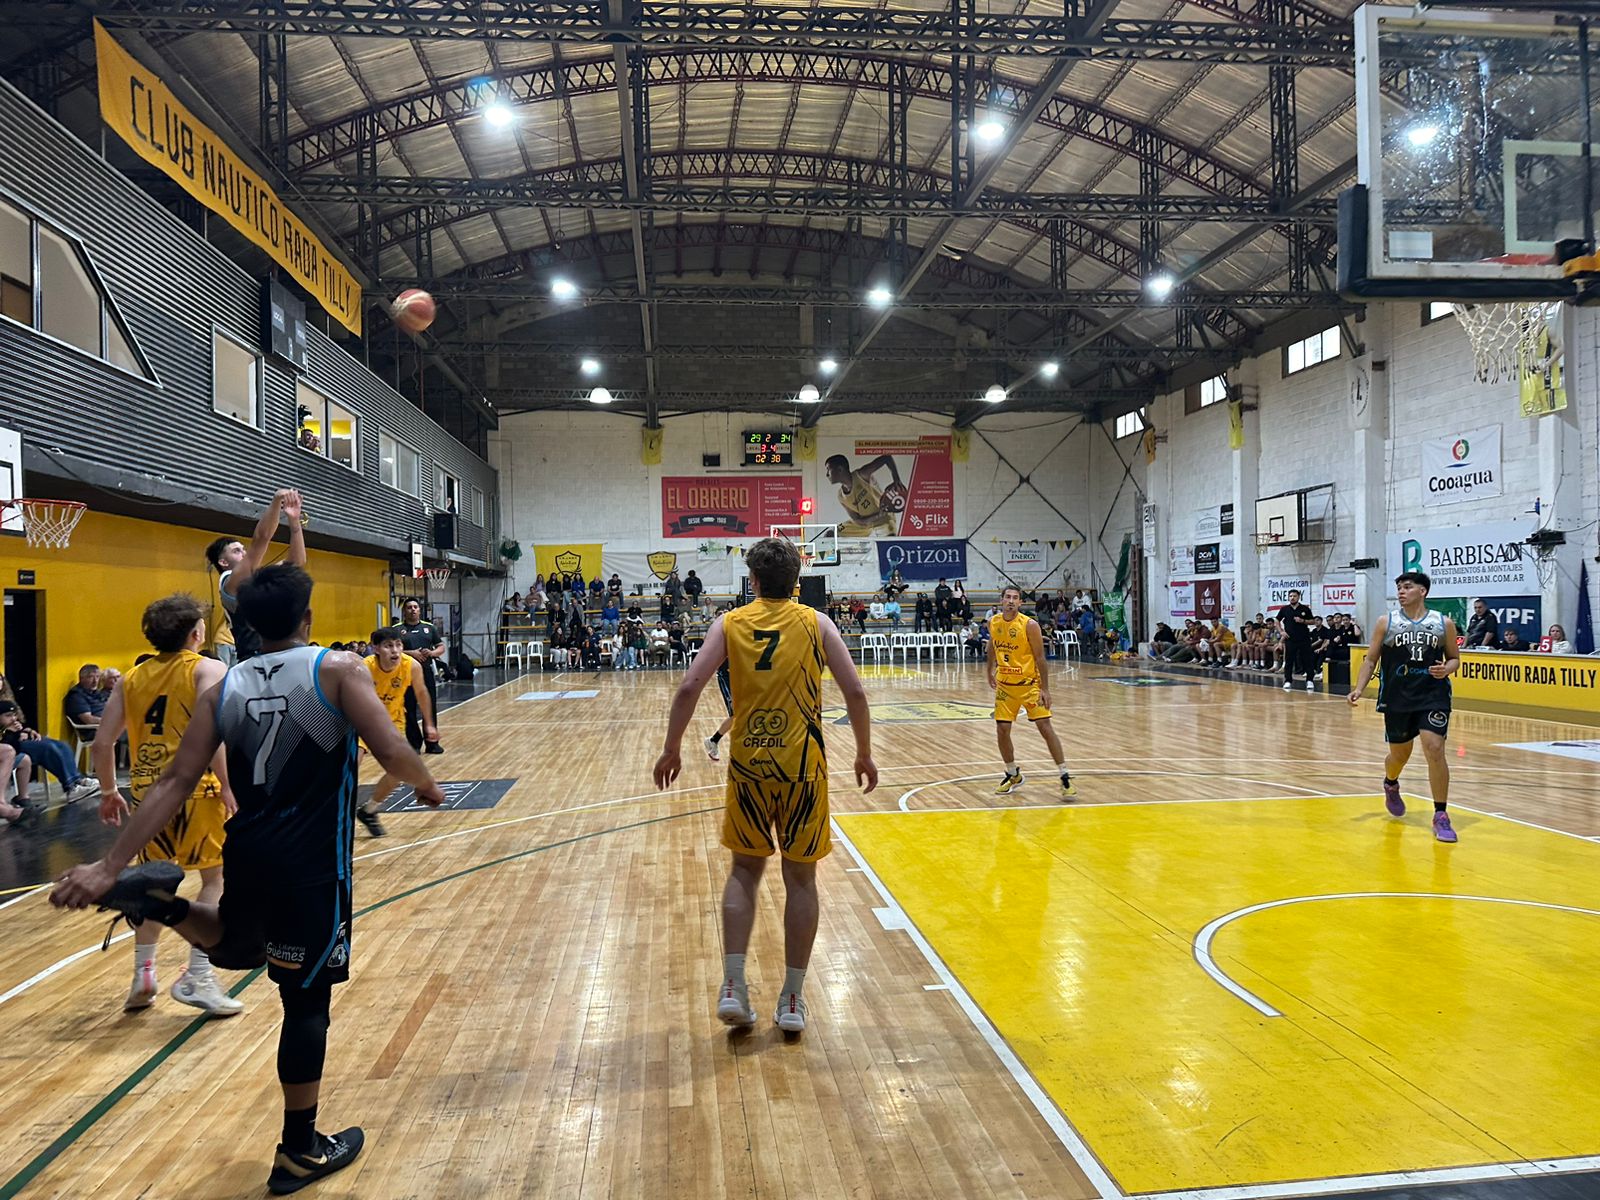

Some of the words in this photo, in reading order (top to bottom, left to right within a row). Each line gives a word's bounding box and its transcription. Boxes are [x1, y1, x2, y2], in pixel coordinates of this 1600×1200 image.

[130, 75, 195, 181] CLUB
[203, 142, 281, 249] NAUTICO
[283, 218, 319, 285] RADA
[322, 259, 351, 317] TILLY
[750, 433, 762, 443] 29
[765, 433, 772, 443] 2
[780, 433, 791, 443] 34
[761, 444, 767, 453] 3
[755, 454, 767, 463] 02
[770, 454, 781, 463] 38
[1428, 469, 1493, 493] Cooagua
[667, 487, 683, 509] EL
[688, 487, 749, 509] OBRERO
[925, 513, 948, 525] Flix
[886, 545, 960, 565] Orizon
[1430, 542, 1523, 568] BARBISAN
[1431, 566, 1481, 576] REVESTIMIENTOS
[1487, 564, 1523, 573] MONTAJES
[1268, 580, 1279, 588] Pan
[1280, 579, 1309, 588] American
[1431, 574, 1525, 585] WWW.BARBISAN.COM.AR
[1272, 590, 1305, 602] ENEY
[1326, 589, 1355, 600] LUFK
[1489, 608, 1535, 625] YPF
[1395, 632, 1439, 649] CALETA
[1541, 639, 1550, 651] 5
[753, 630, 780, 671] 7
[1410, 646, 1424, 661] 11
[1003, 654, 1010, 662] 5
[1462, 661, 1521, 683] DEPORTIVO
[1524, 666, 1557, 686] RADA
[1560, 668, 1596, 689] TILLY
[144, 694, 168, 735] 4
[245, 695, 289, 786] 7
[743, 737, 787, 748] CREDIL
